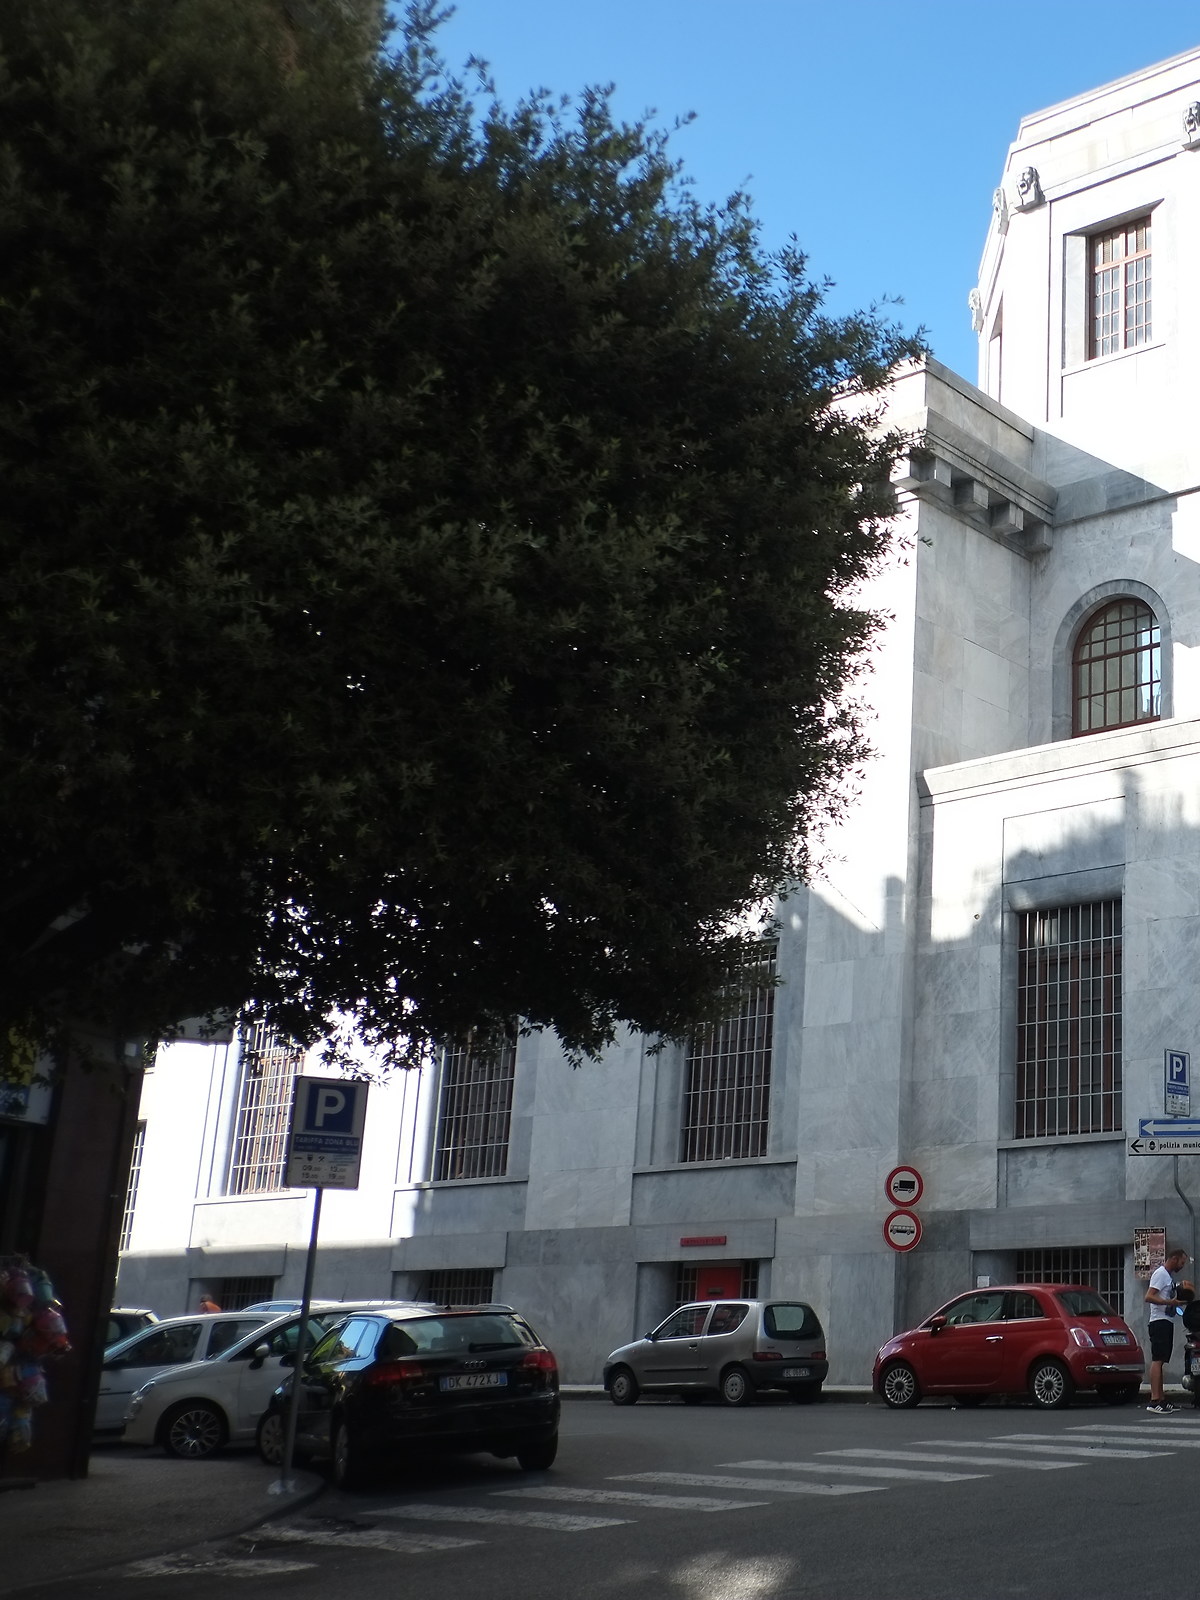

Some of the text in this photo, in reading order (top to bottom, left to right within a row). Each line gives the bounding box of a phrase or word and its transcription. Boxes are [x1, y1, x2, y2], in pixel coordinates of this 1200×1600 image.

[1172, 1056, 1183, 1080] P
[315, 1088, 346, 1127] P
[295, 1136, 323, 1144] TARIFFA
[1160, 1142, 1180, 1150] polizia
